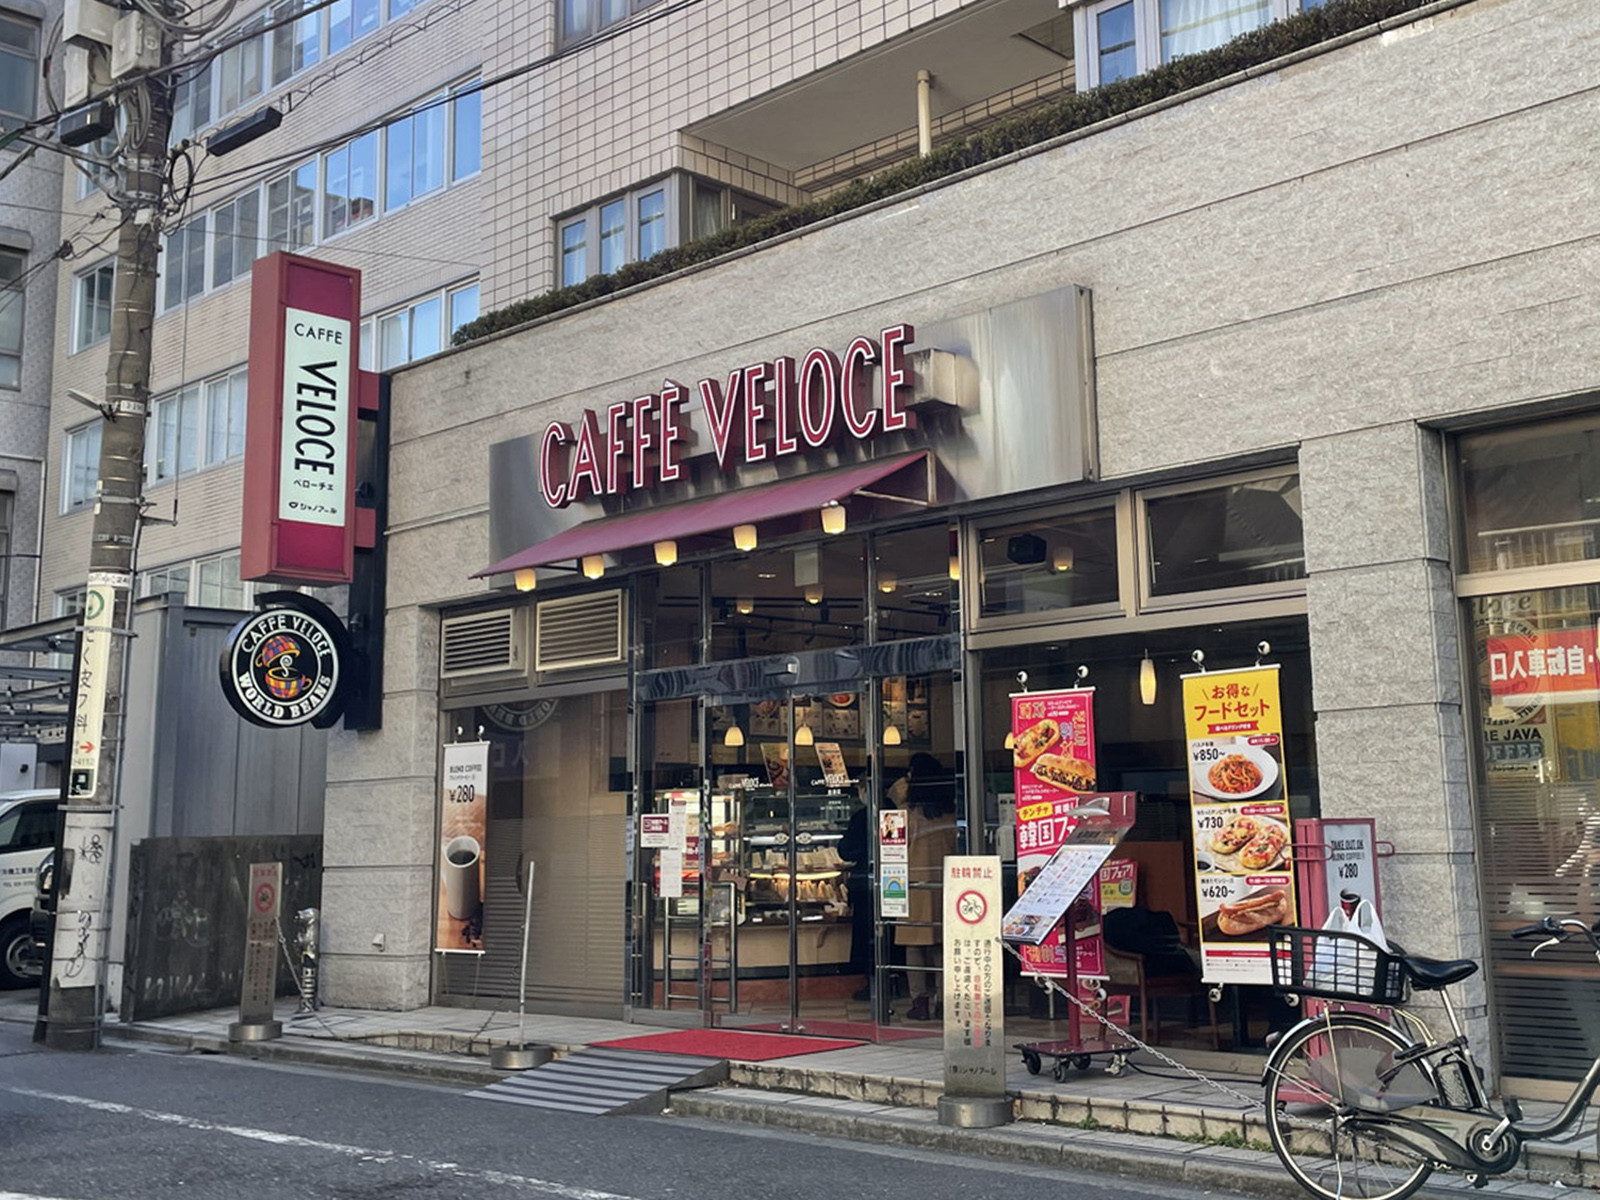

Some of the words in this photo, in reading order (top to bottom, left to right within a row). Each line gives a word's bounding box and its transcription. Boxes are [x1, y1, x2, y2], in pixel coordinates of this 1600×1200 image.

[699, 323, 916, 470] VELOCE
[293, 360, 338, 476] VELOCE
[293, 479, 335, 491] ベローチェ
[293, 616, 331, 657] VELOCE
[239, 671, 285, 718] WORLD
[289, 675, 331, 718] BEANS
[1212, 683, 1250, 700] お得な
[1194, 699, 1270, 721] フードセット
[1503, 728, 1542, 741] JAVA
[449, 784, 475, 803] ¥280
[1198, 816, 1224, 829] ¥730
[1330, 840, 1345, 850] TAKE
[1345, 840, 1356, 850] OUT
[951, 867, 993, 879] 駐輪禁止
[1338, 862, 1359, 878] ¥280
